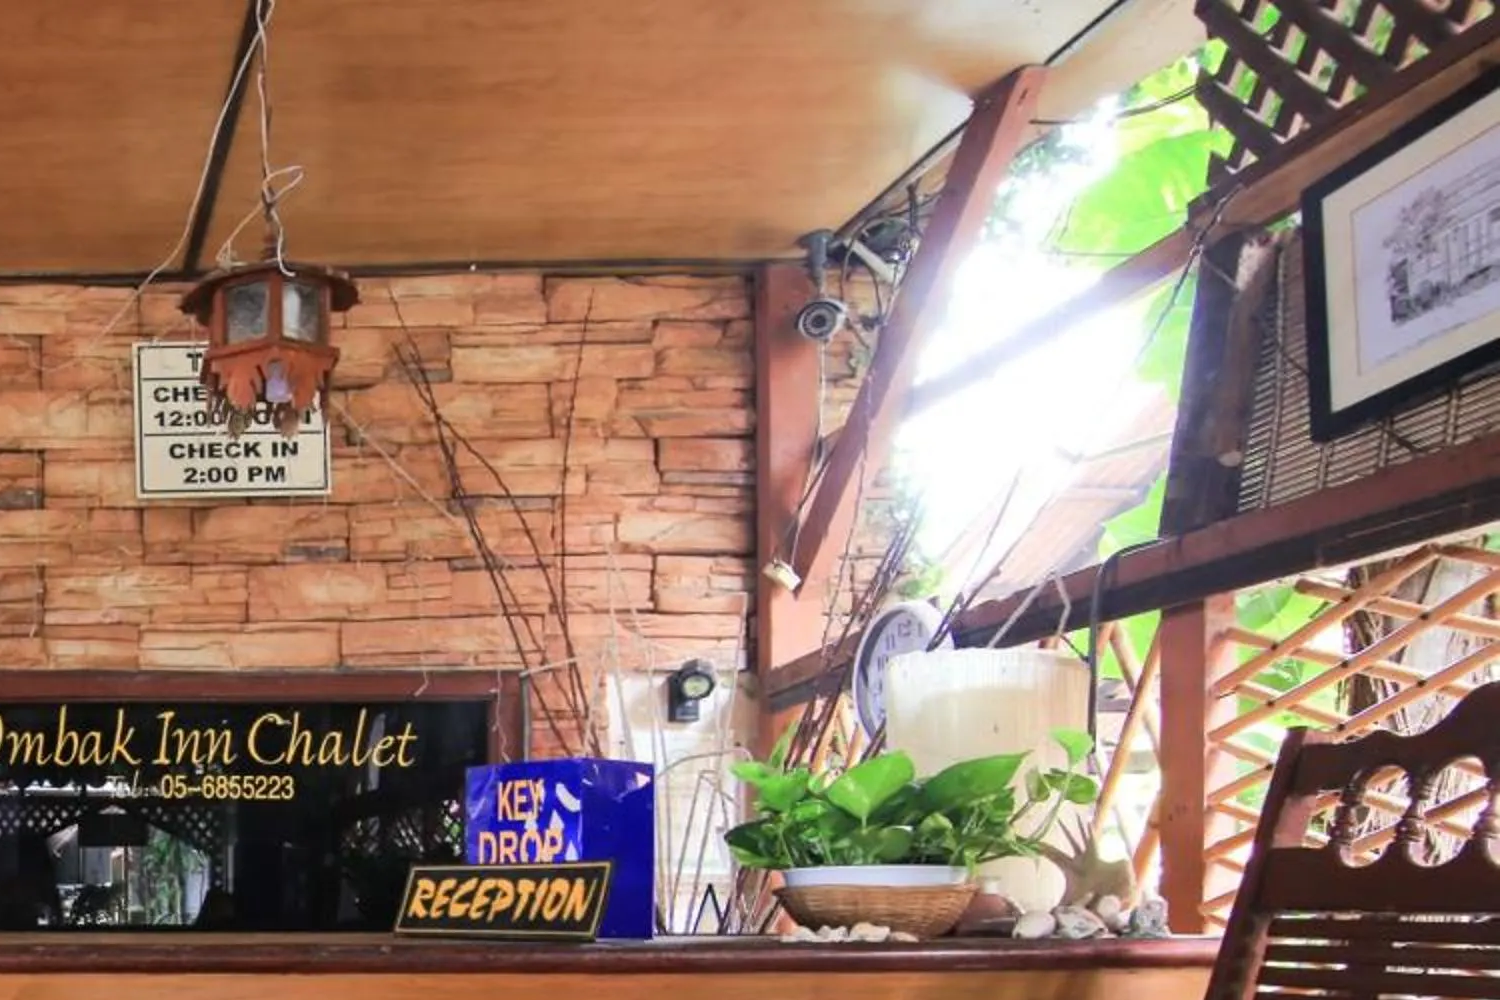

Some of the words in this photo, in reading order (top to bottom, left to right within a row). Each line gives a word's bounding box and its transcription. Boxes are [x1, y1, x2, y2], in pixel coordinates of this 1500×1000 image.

[169, 442, 262, 459] CHECK
[271, 441, 299, 457] IN
[183, 467, 238, 483] 2:00
[248, 466, 286, 482] PM
[152, 710, 238, 766] Inn
[247, 707, 418, 767] Chalet
[160, 774, 295, 800] 05-6855223
[497, 778, 544, 821] KEY
[479, 829, 563, 864] DROP
[407, 876, 597, 924] RECEPTION
